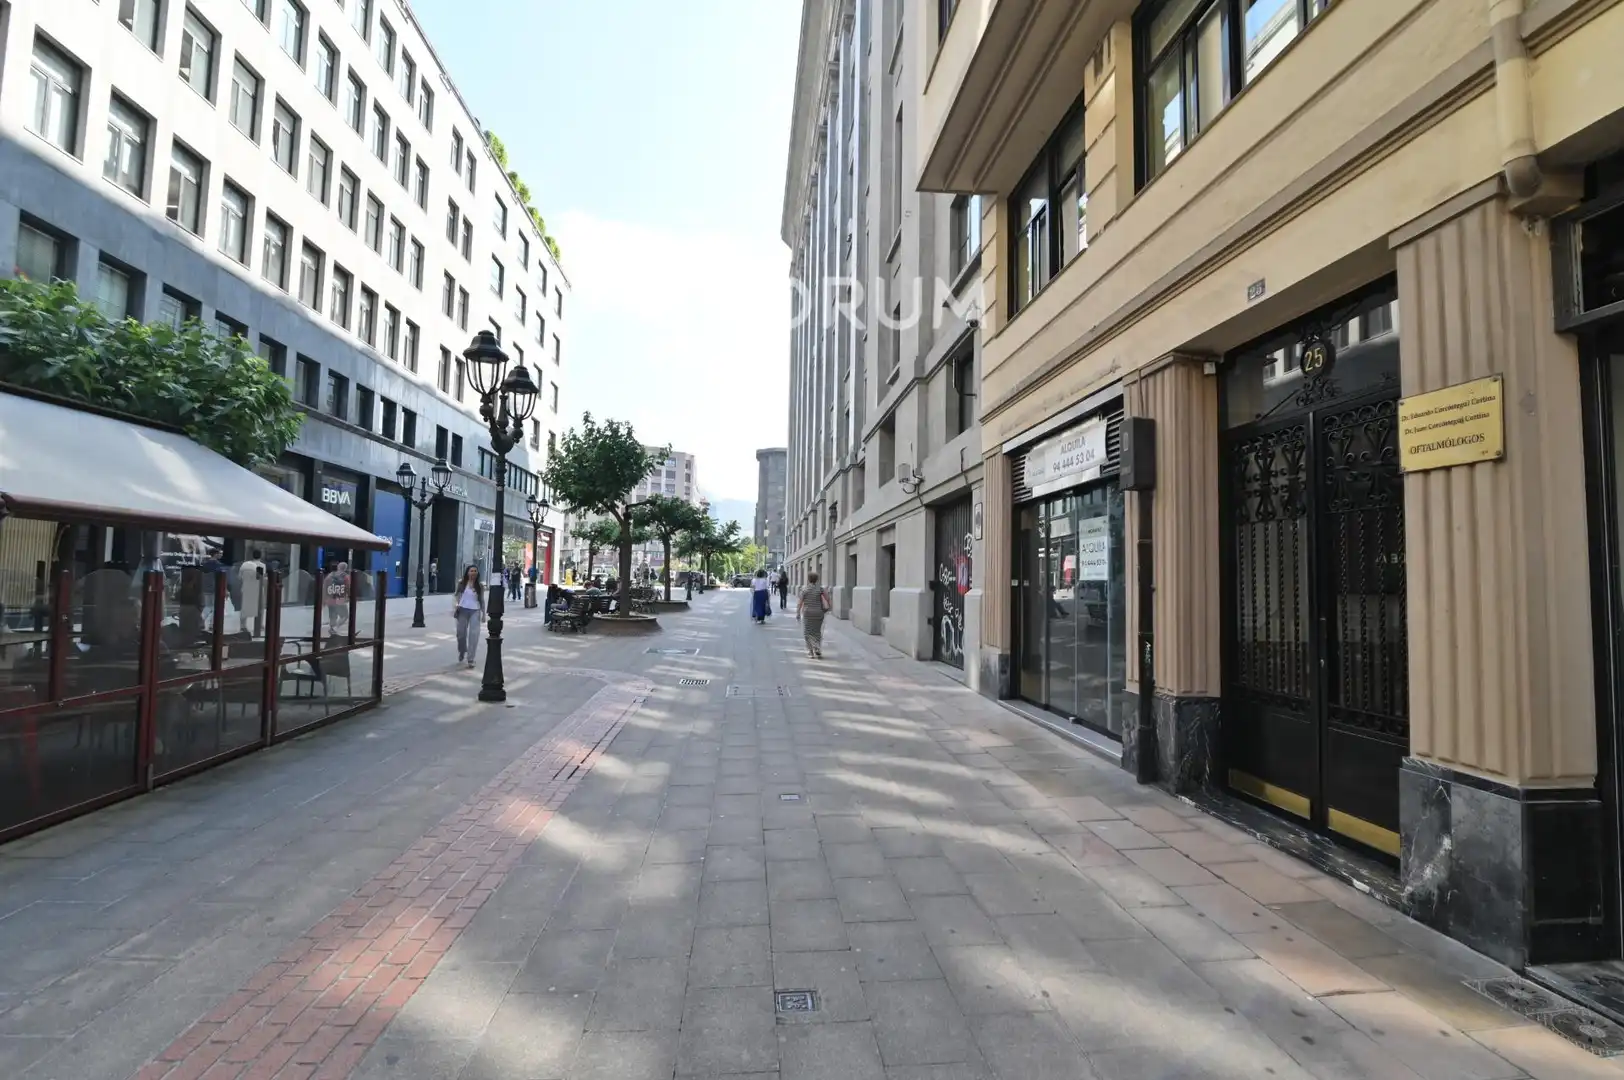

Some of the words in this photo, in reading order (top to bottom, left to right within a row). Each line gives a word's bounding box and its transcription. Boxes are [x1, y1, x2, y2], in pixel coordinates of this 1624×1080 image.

[1304, 347, 1323, 371] 25
[1061, 436, 1086, 455] ALQUILA
[1409, 433, 1486, 455] OFTALMÓLOGOS
[1053, 460, 1061, 472] 94
[1062, 456, 1074, 469] 444
[1076, 451, 1085, 465] 53
[1086, 448, 1095, 462] 04
[321, 487, 351, 505] BBVA
